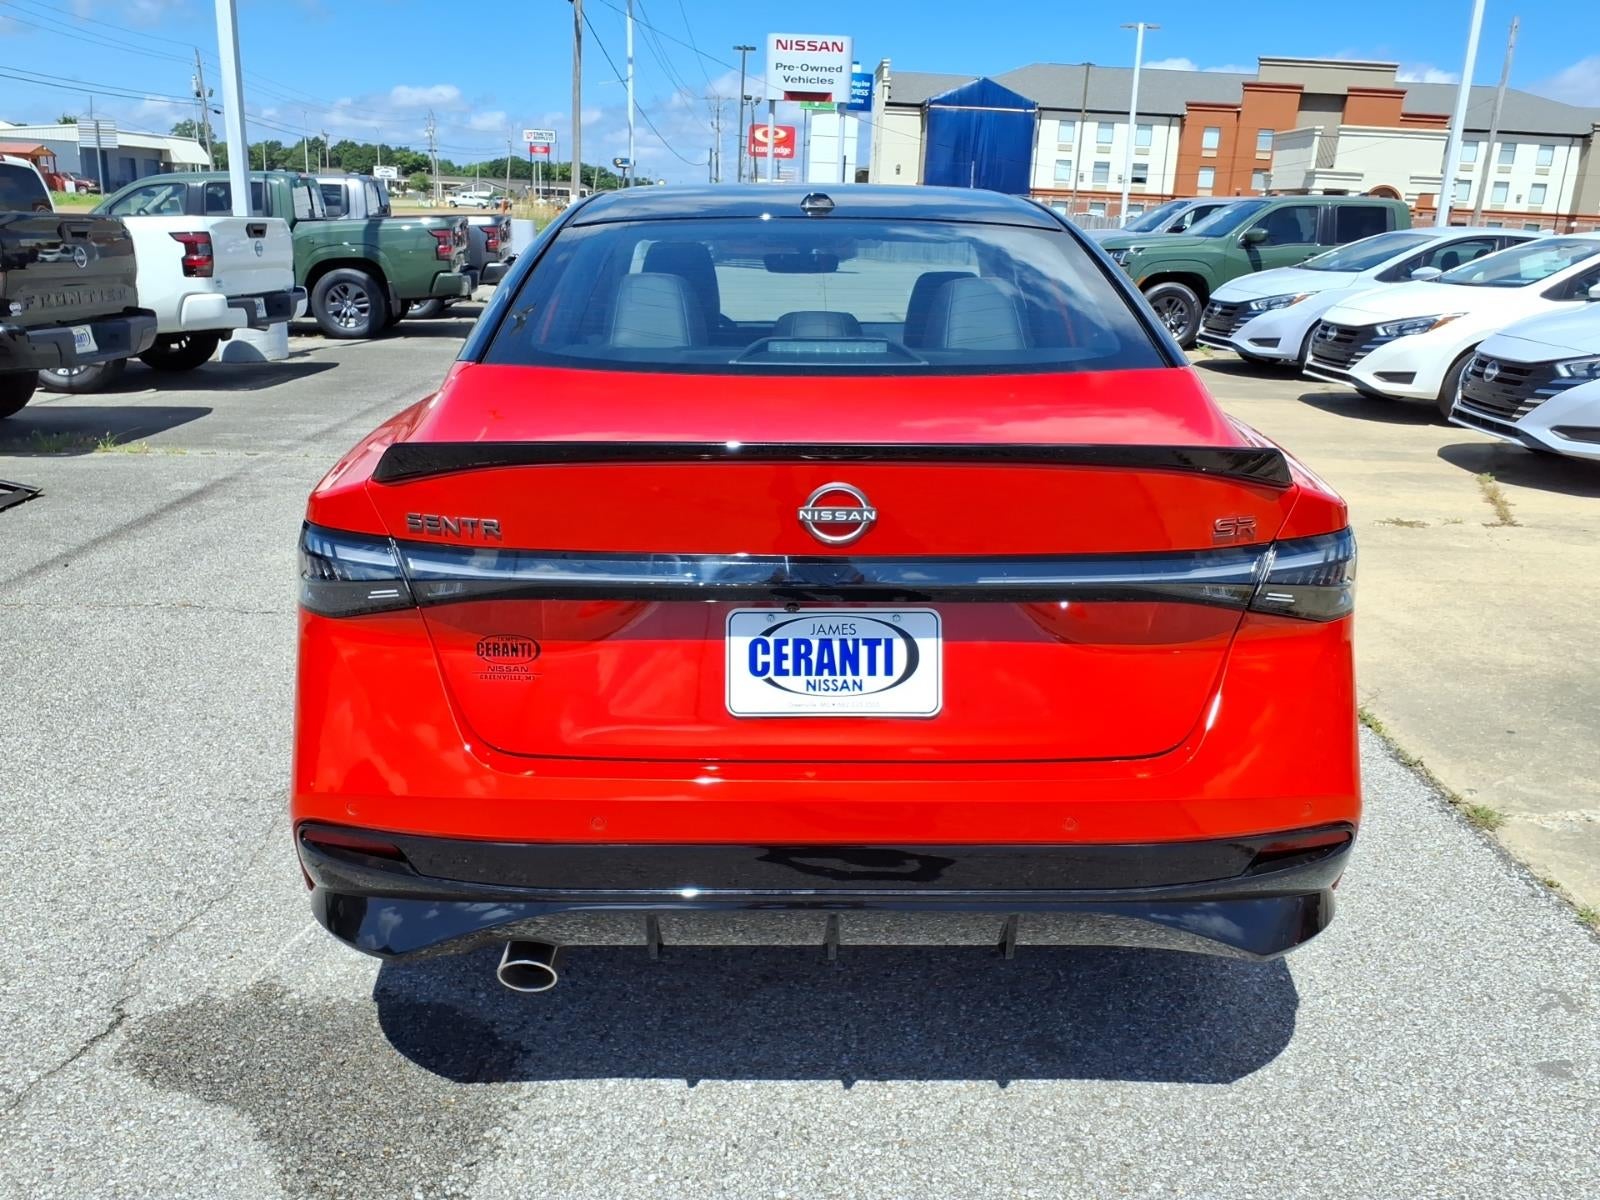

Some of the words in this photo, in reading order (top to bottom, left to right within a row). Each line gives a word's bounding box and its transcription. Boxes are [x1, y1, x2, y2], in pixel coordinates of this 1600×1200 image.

[775, 39, 844, 53] NISSAN
[775, 62, 843, 73] Pre-Owned
[783, 75, 834, 85] Vehicles
[799, 510, 876, 521] NISSAN
[407, 512, 502, 537] SENTR
[1213, 516, 1256, 537] SR
[810, 623, 857, 636] JAMES
[476, 642, 532, 657] CERANTI
[748, 637, 893, 677] CERANTI
[488, 665, 529, 673] NISSAN
[806, 679, 863, 692] NISSAN
